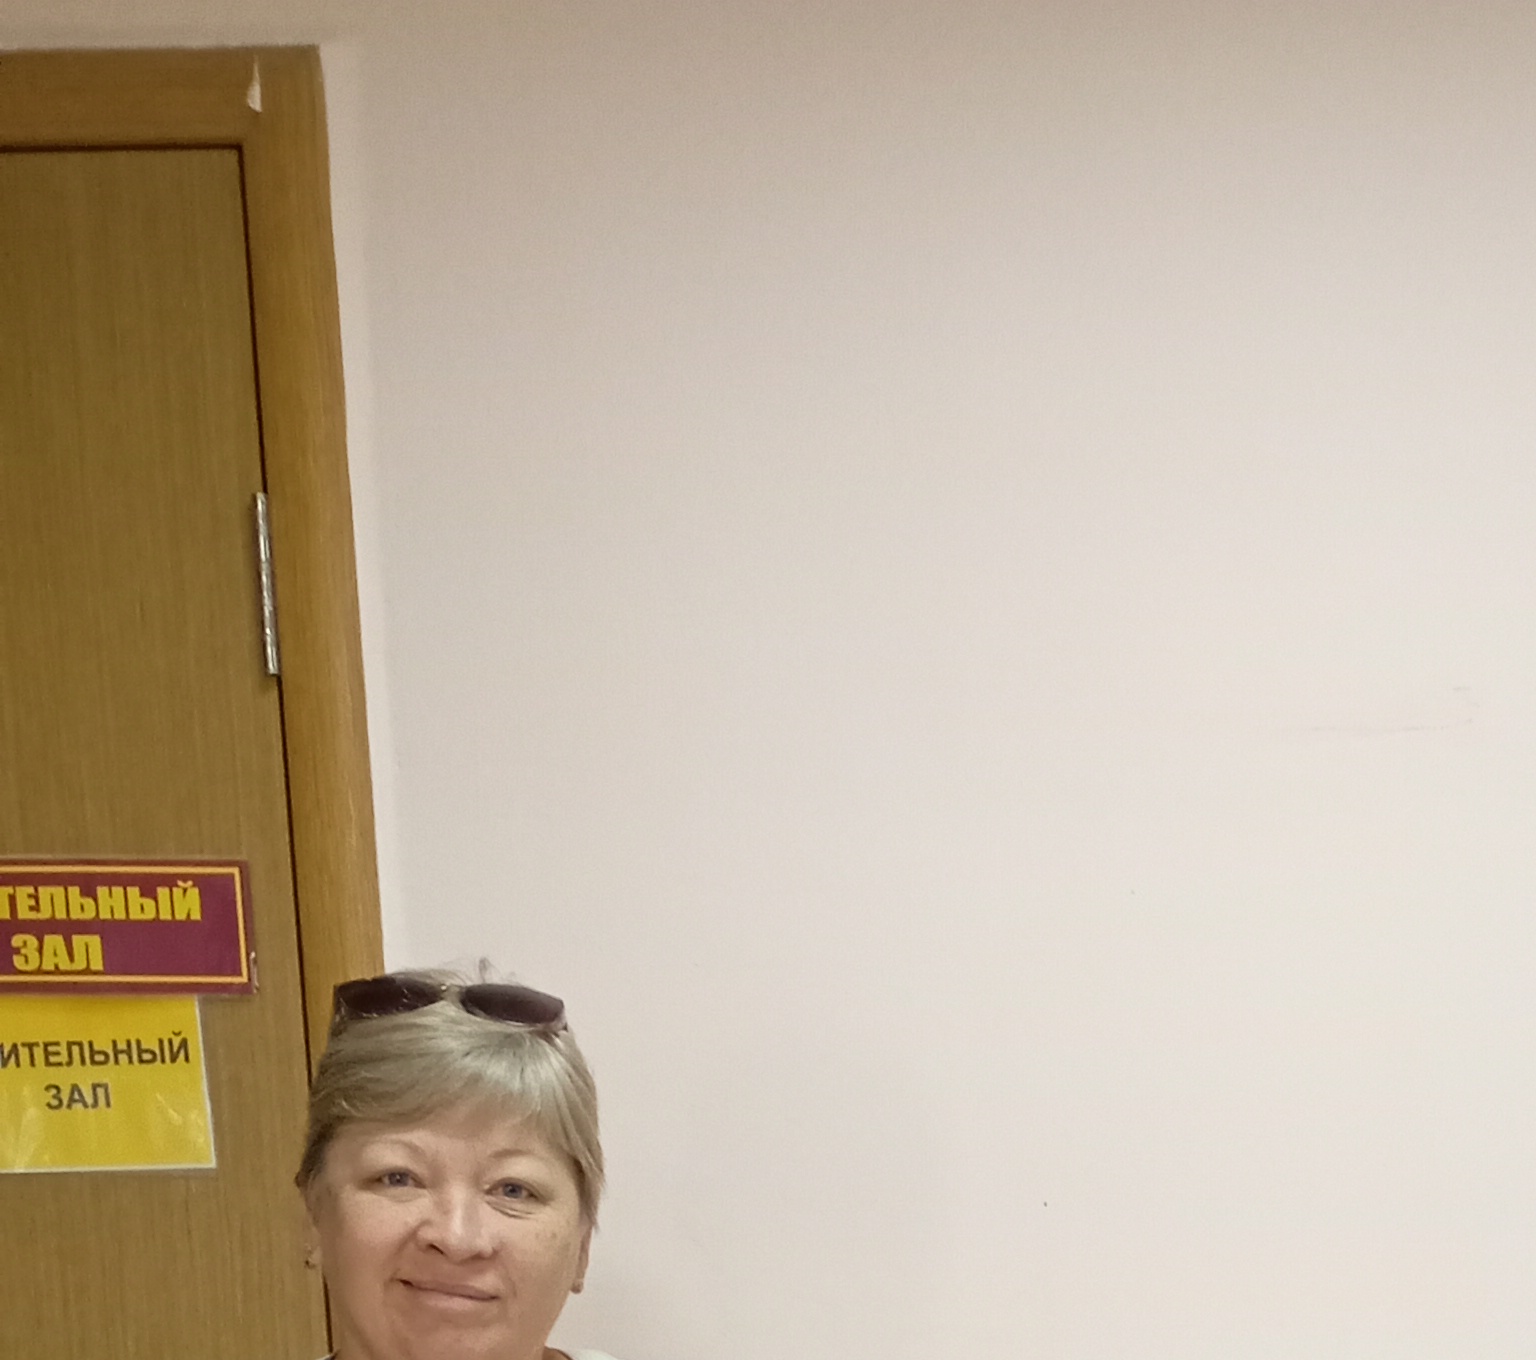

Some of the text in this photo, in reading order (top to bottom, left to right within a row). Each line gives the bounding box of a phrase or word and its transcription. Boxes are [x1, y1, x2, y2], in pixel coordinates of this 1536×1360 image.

[0, 880, 201, 921] ТЕЛЬНЫЙ
[11, 934, 104, 972] ЗАЛ
[0, 1031, 190, 1069] ИТЕЛЬНЫЙ
[45, 1083, 112, 1110] ЗАЛ
